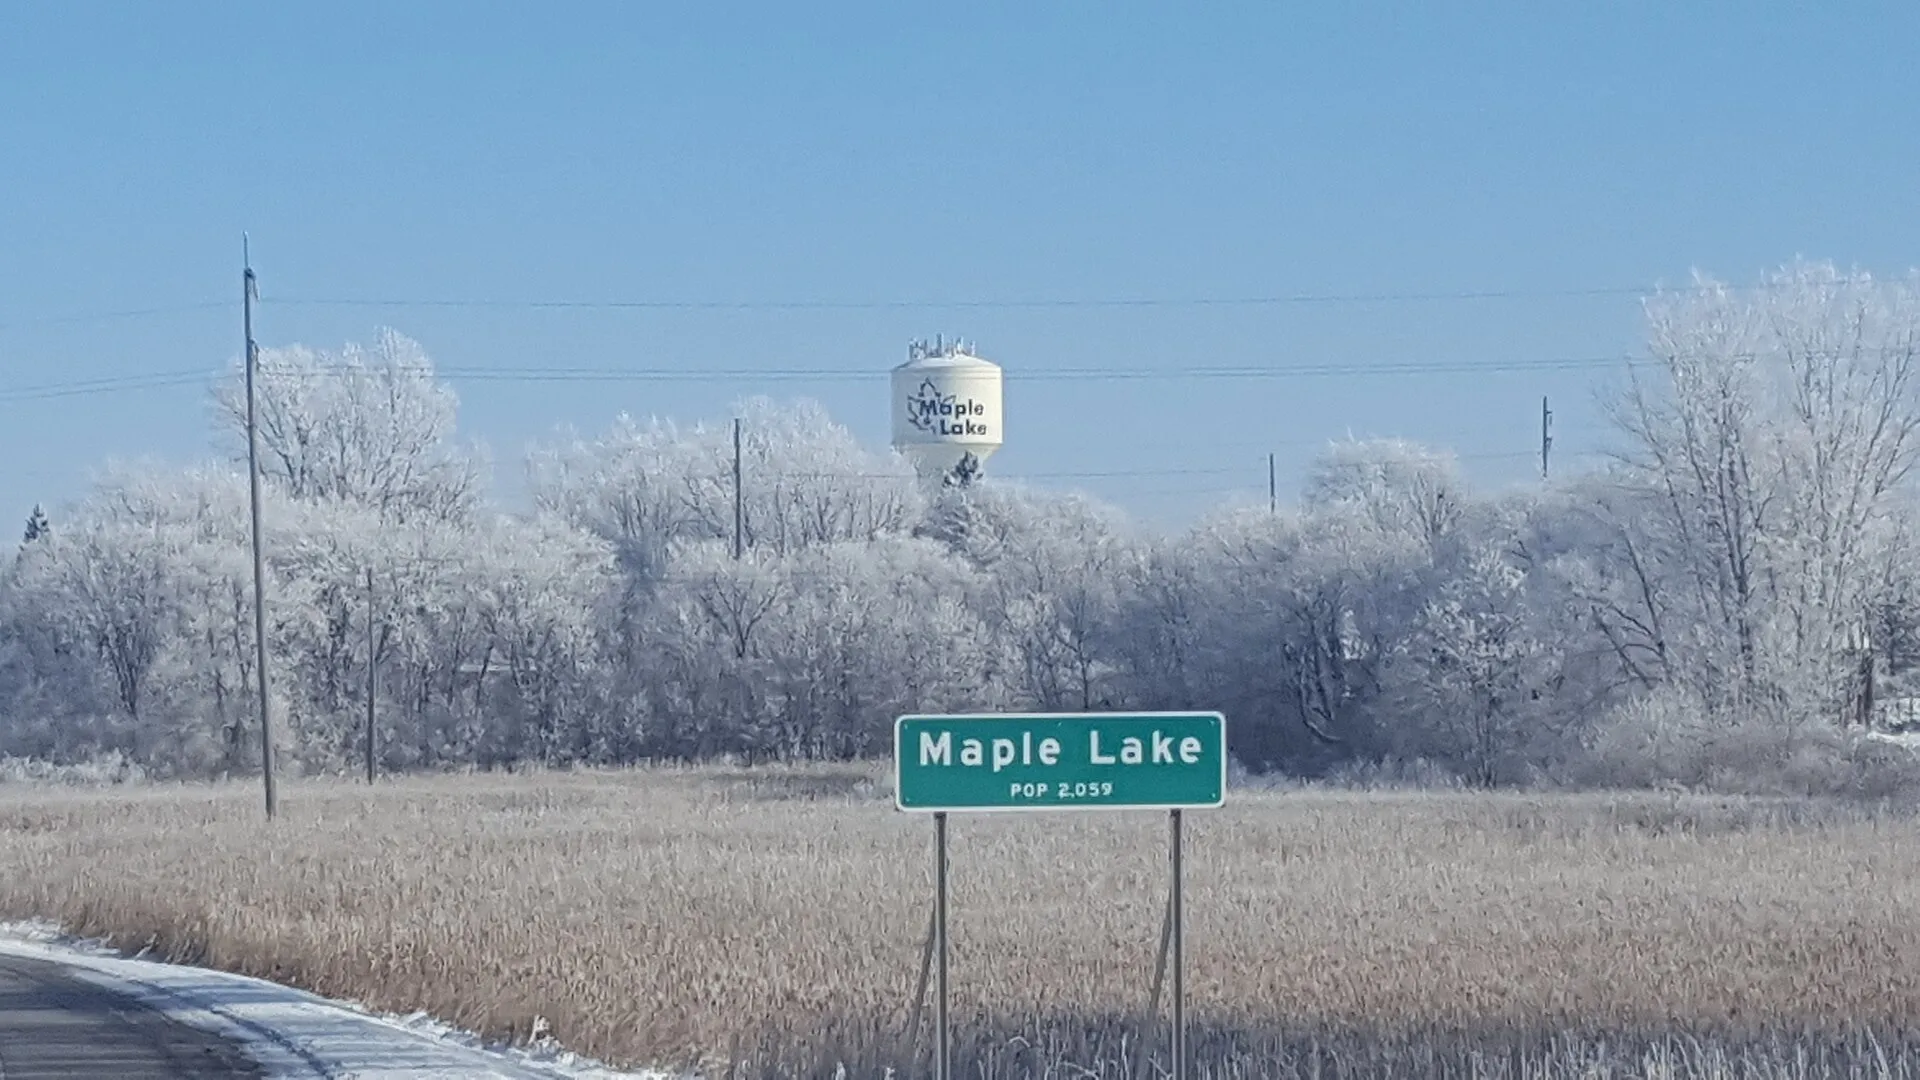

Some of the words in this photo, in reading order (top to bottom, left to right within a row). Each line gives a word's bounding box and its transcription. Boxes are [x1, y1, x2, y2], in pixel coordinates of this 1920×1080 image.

[919, 399, 984, 420] Maple
[940, 419, 987, 435] Lake
[919, 731, 1061, 772] Maple
[1090, 730, 1201, 764] Lake
[1010, 783, 1048, 797] POP
